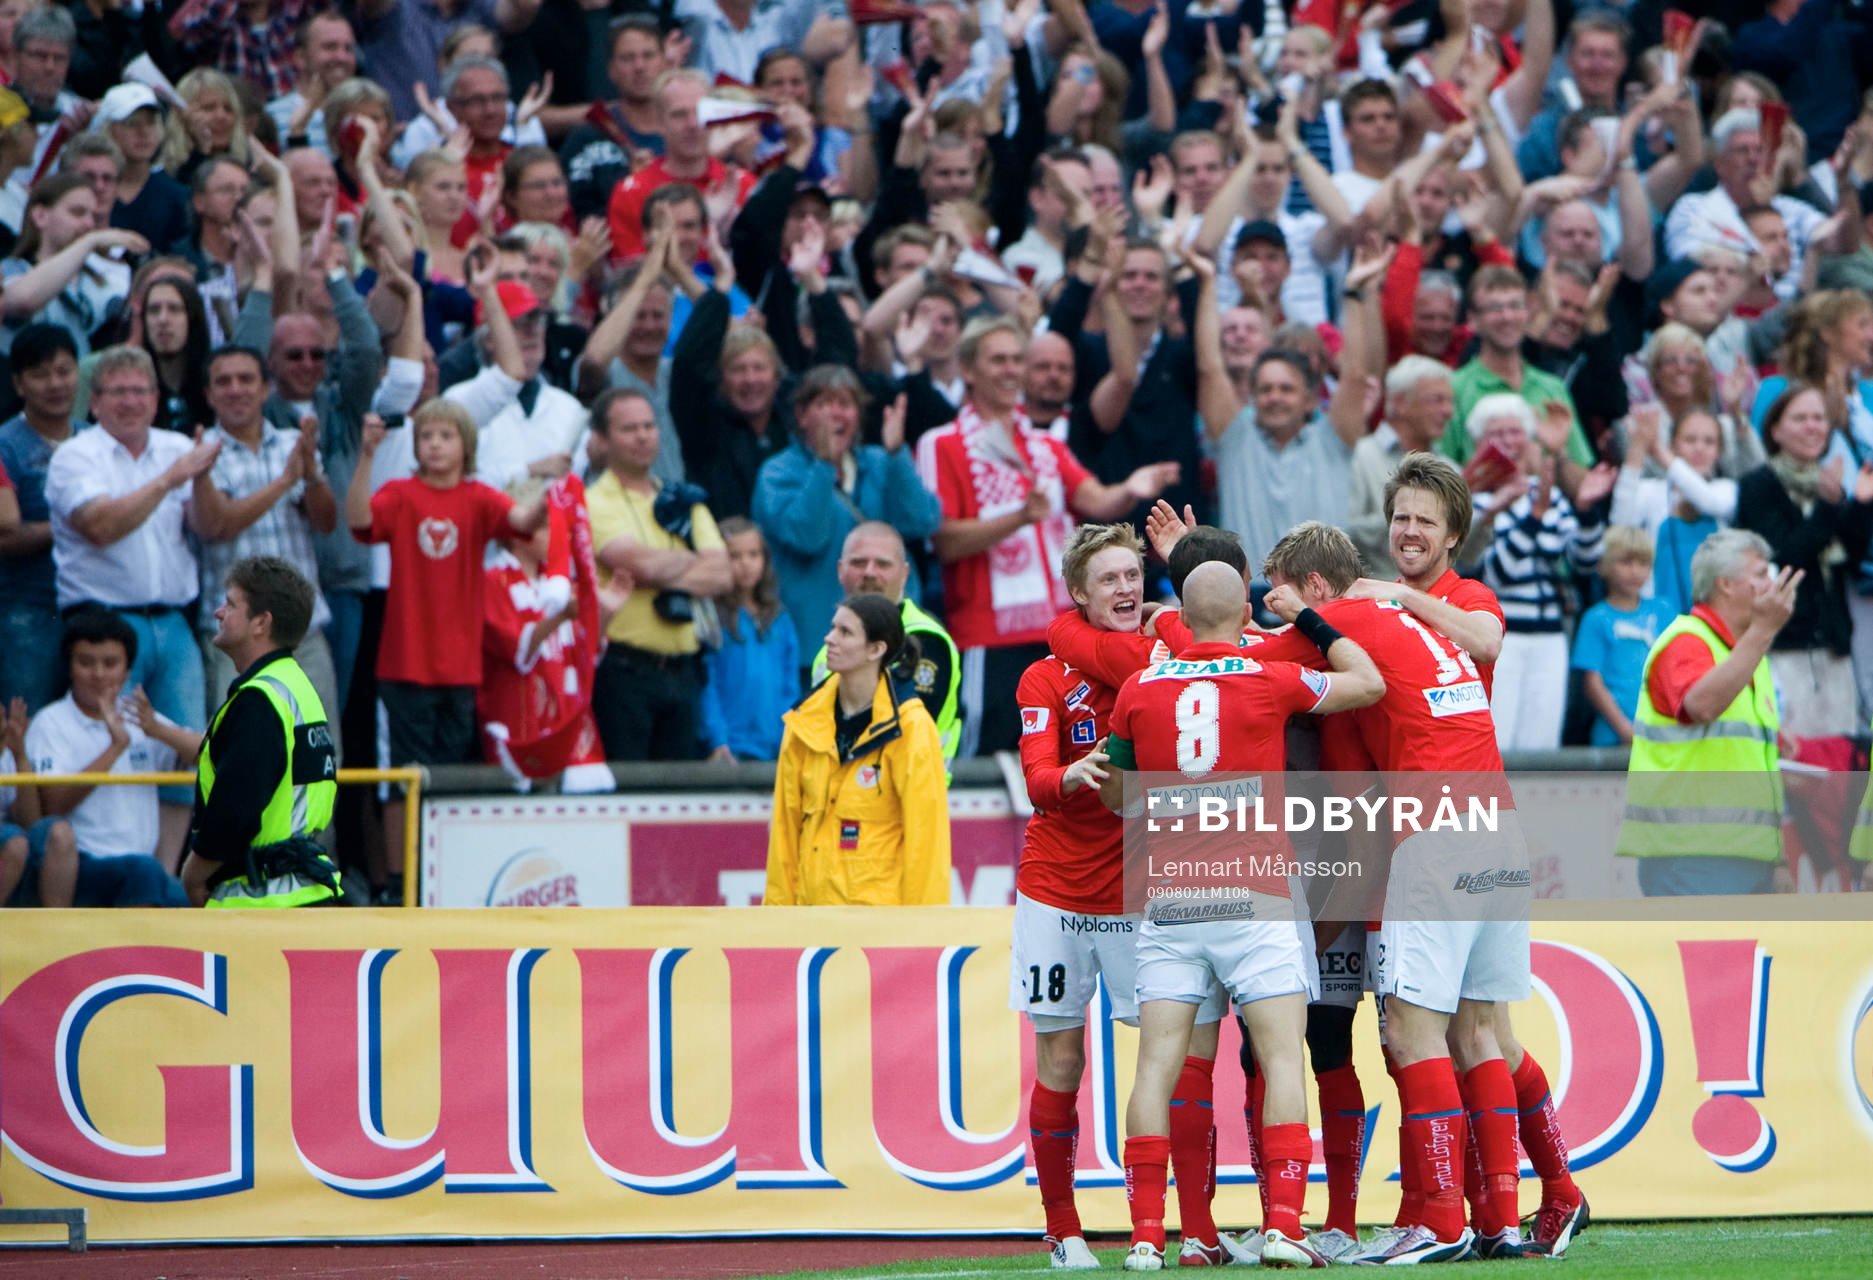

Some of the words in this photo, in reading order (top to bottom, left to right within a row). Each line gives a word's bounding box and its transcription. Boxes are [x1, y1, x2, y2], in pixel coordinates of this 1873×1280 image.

[1155, 658, 1245, 676] PEAB
[1175, 680, 1221, 779] 8
[1164, 781, 1260, 805] MOTOMAN
[1060, 916, 1133, 936] Nybloms
[1029, 963, 1066, 1004] 18
[1433, 1159, 1455, 1190] ontuz
